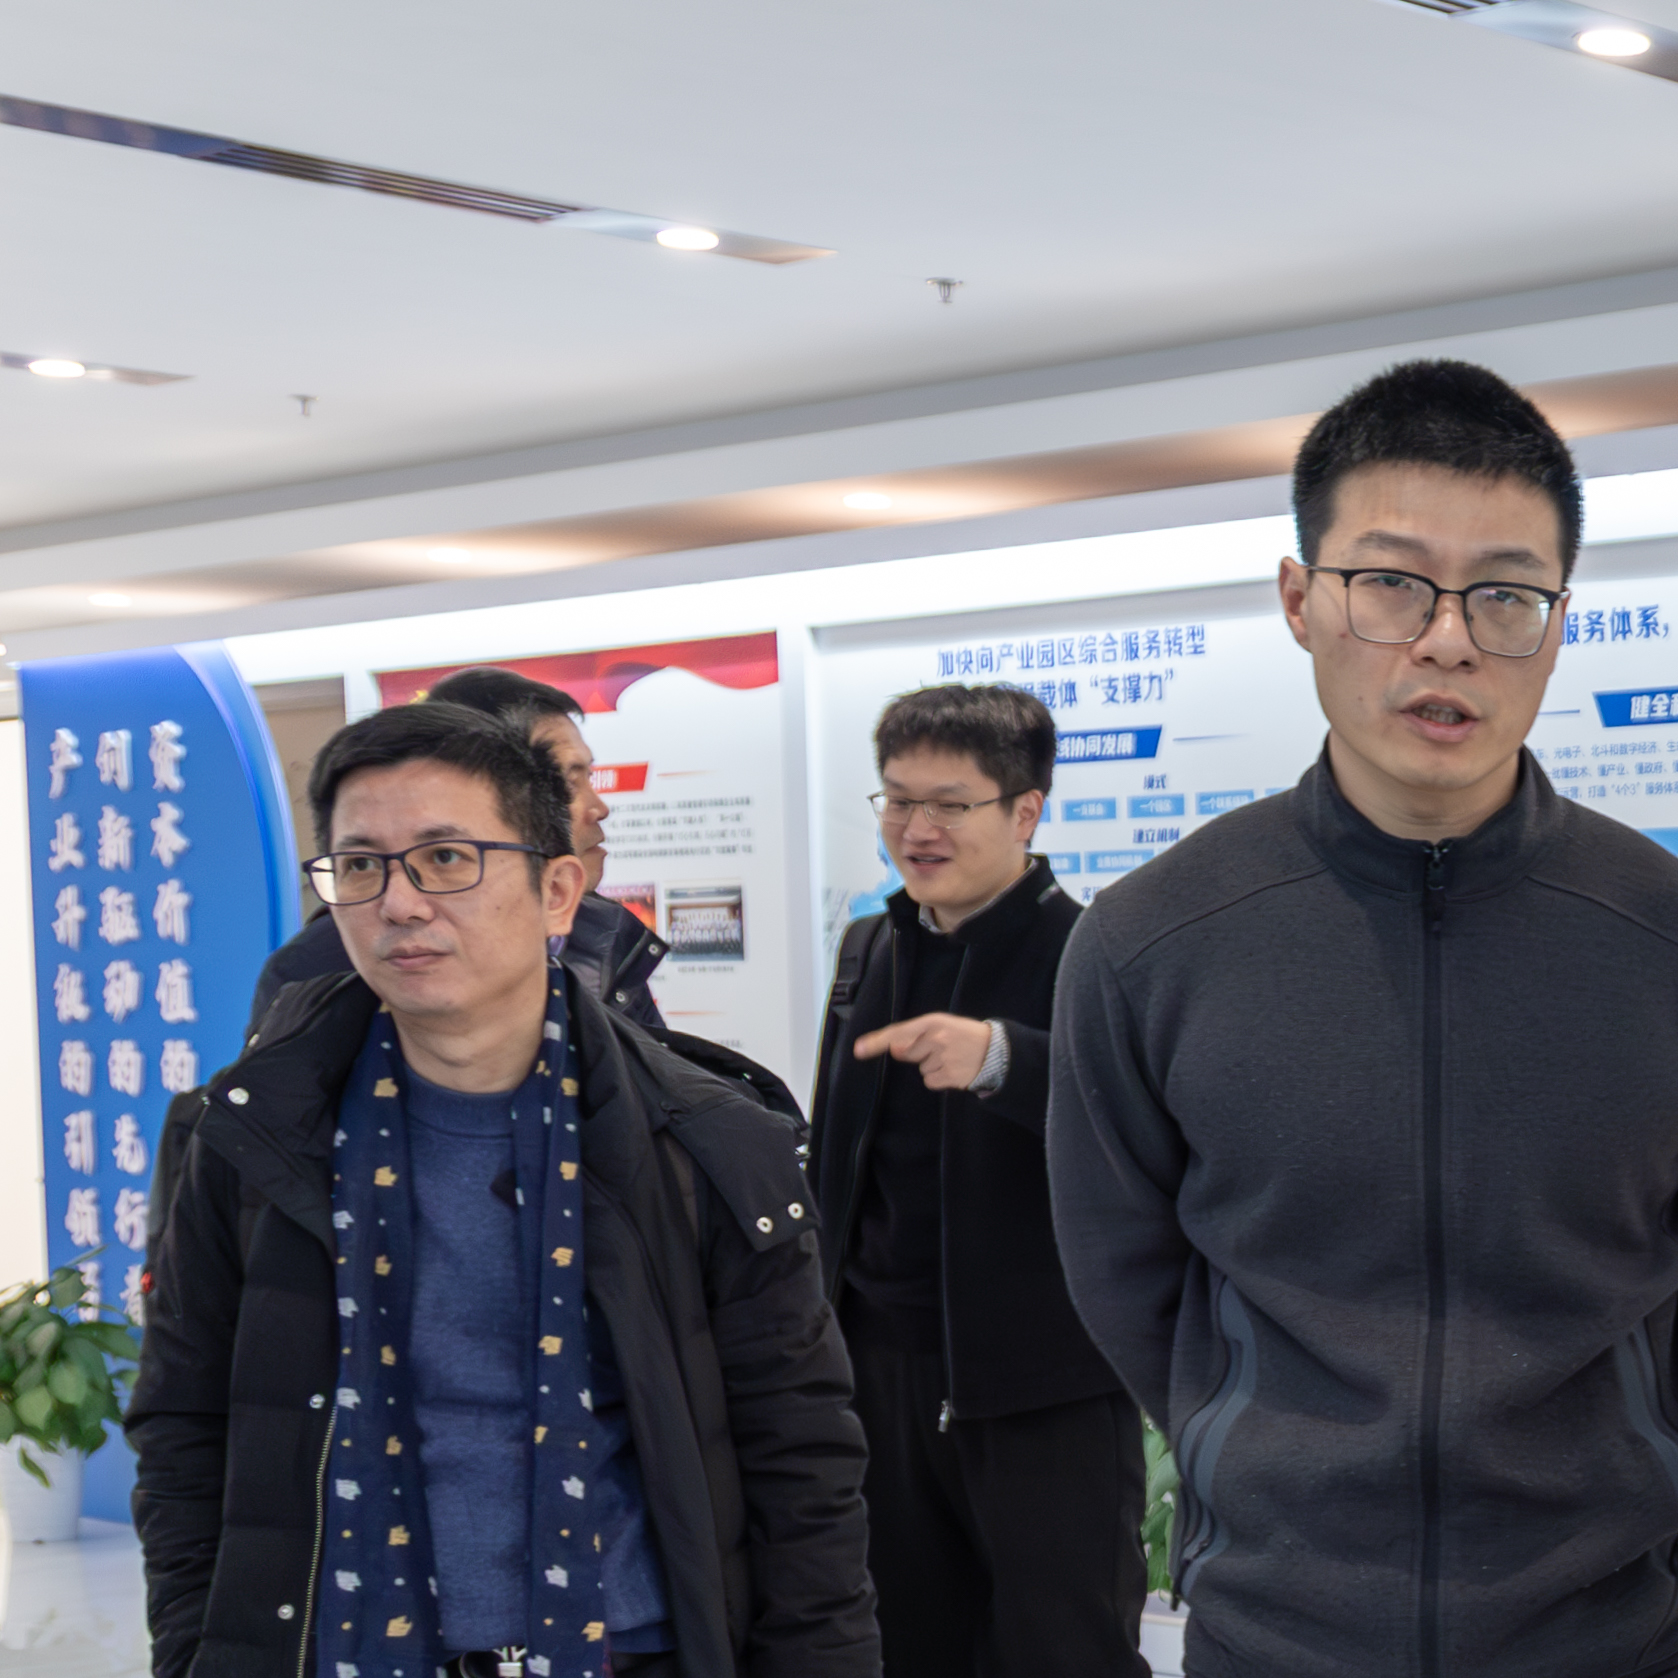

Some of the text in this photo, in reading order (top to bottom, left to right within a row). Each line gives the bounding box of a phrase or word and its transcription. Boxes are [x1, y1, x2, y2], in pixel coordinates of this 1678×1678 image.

[936, 624, 1206, 677] 加快向产业园区综合服务转型
